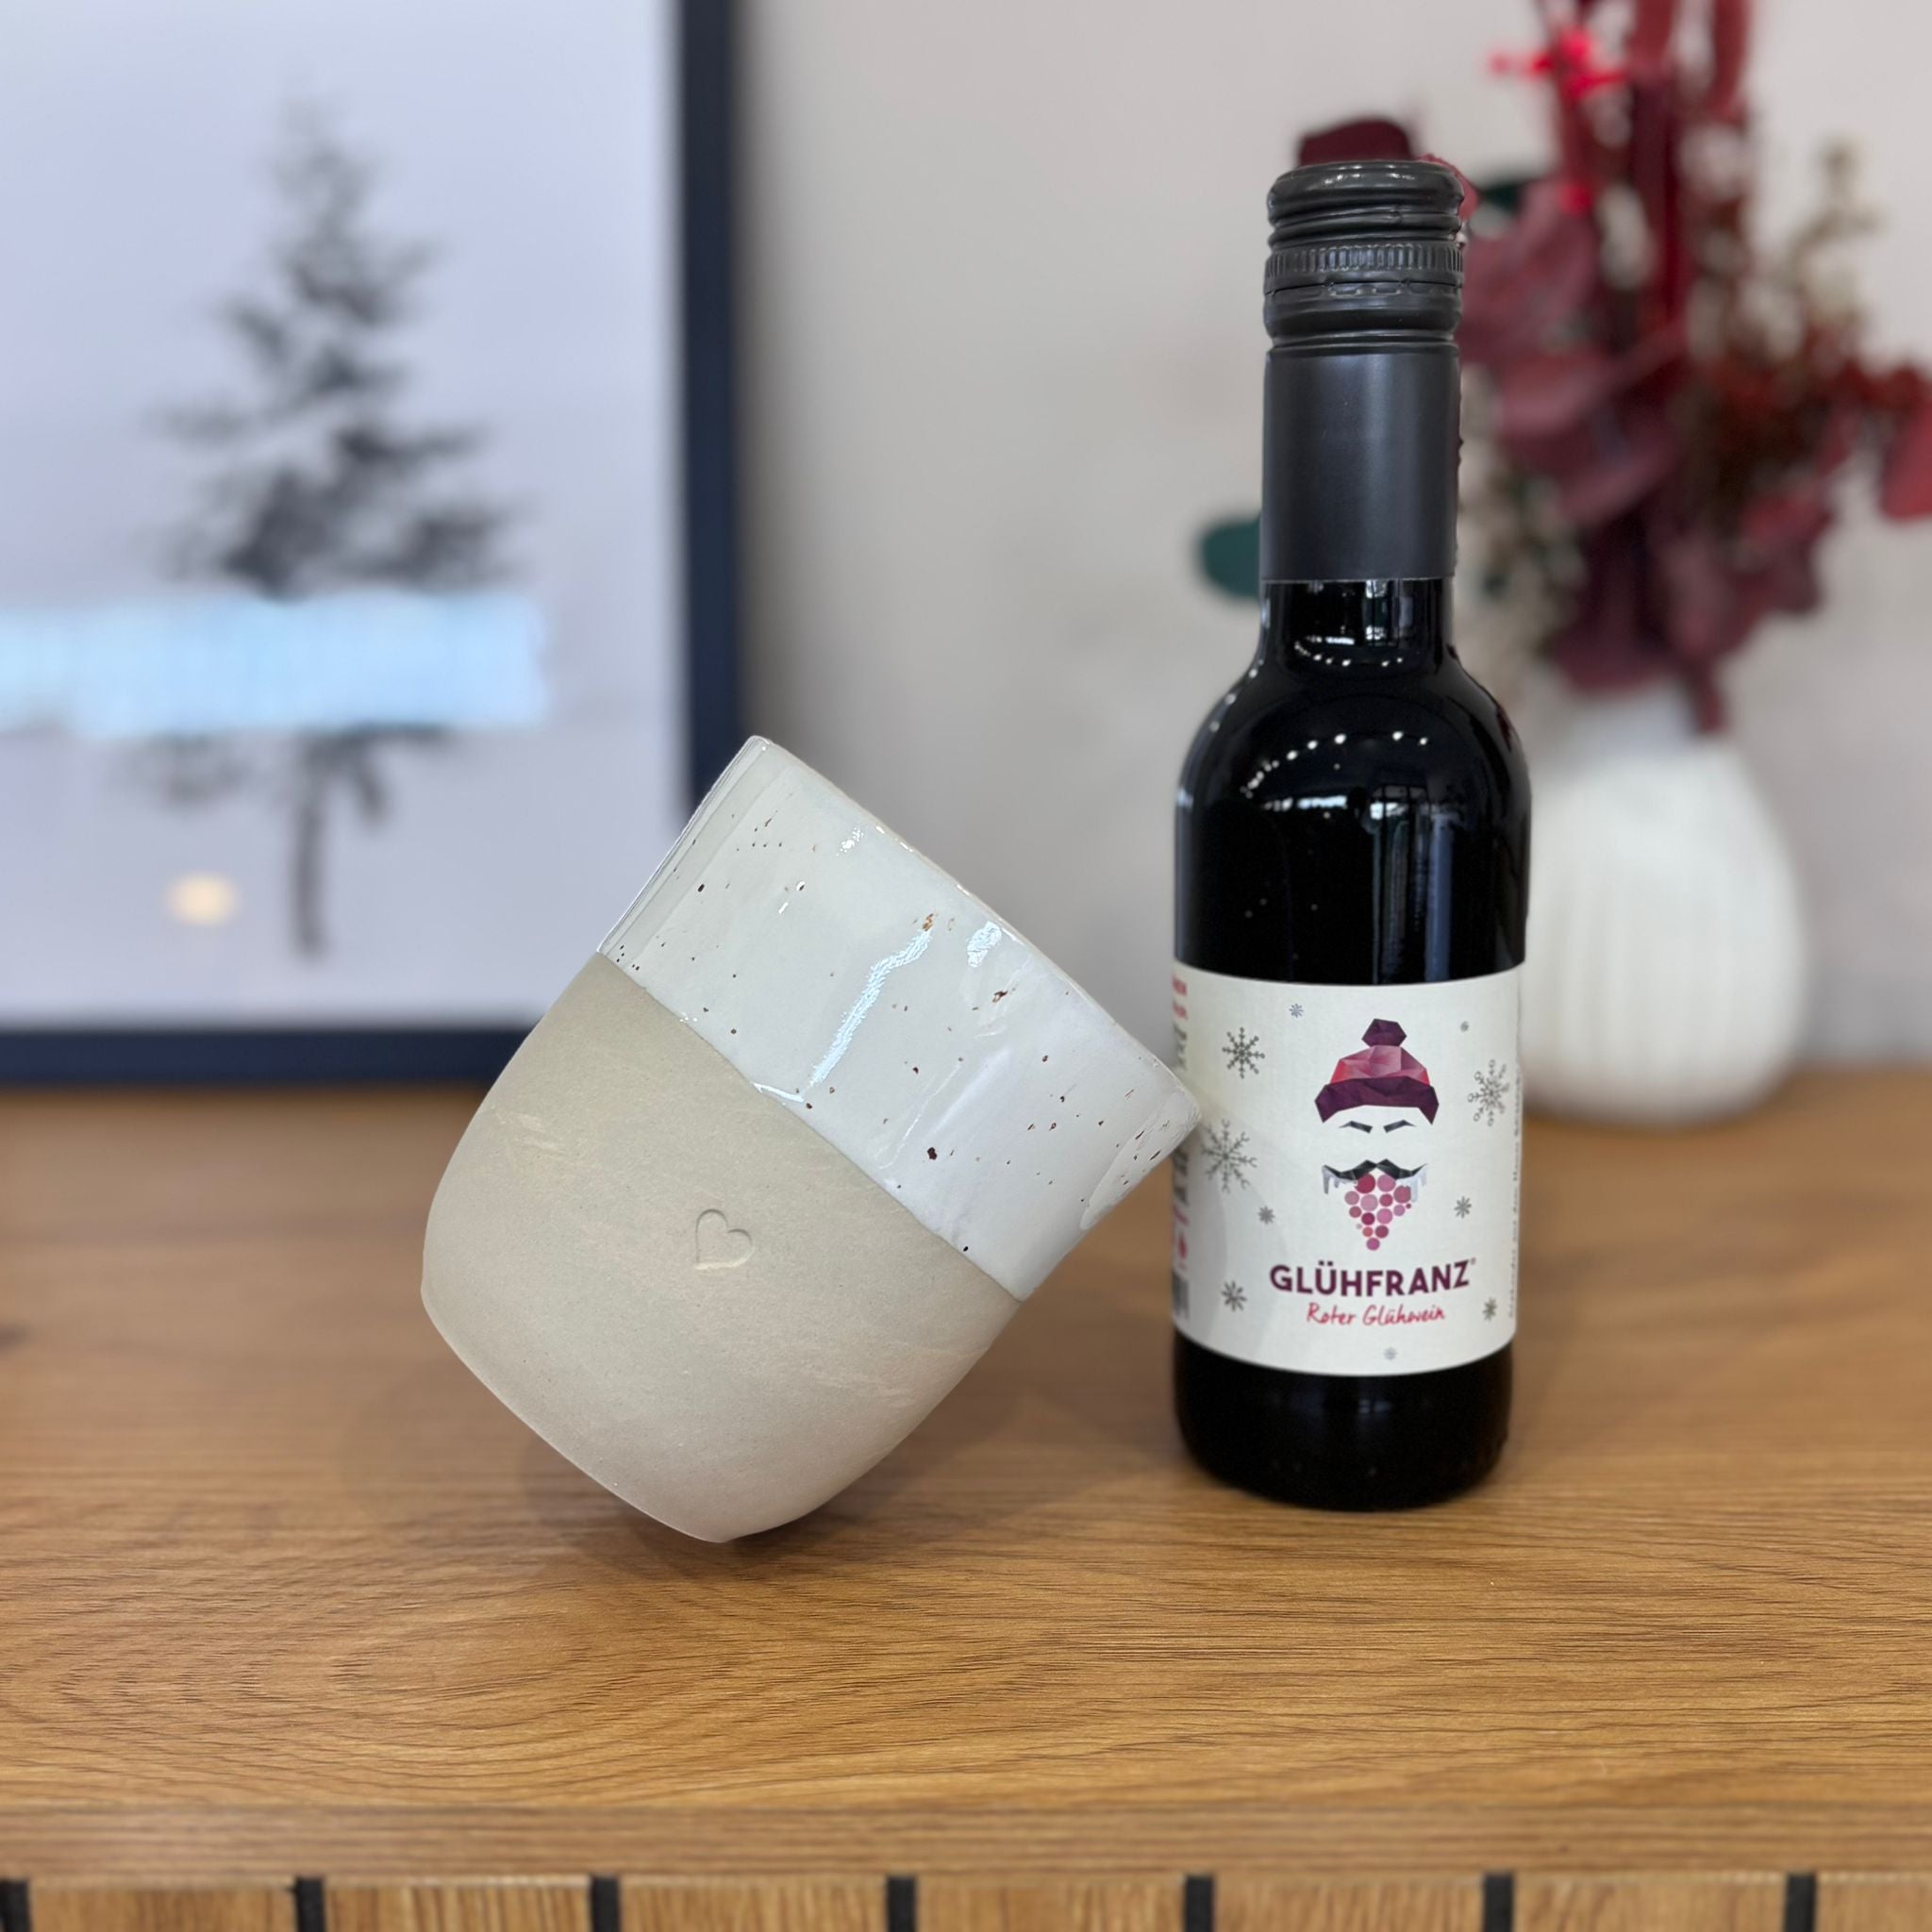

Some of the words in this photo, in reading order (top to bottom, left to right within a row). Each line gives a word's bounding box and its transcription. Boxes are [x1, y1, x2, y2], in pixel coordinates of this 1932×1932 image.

[1270, 1259, 1471, 1297] GLÜHFRANZ
[1307, 1302, 1357, 1324] Roter
[1362, 1303, 1445, 1326] Glühwein
